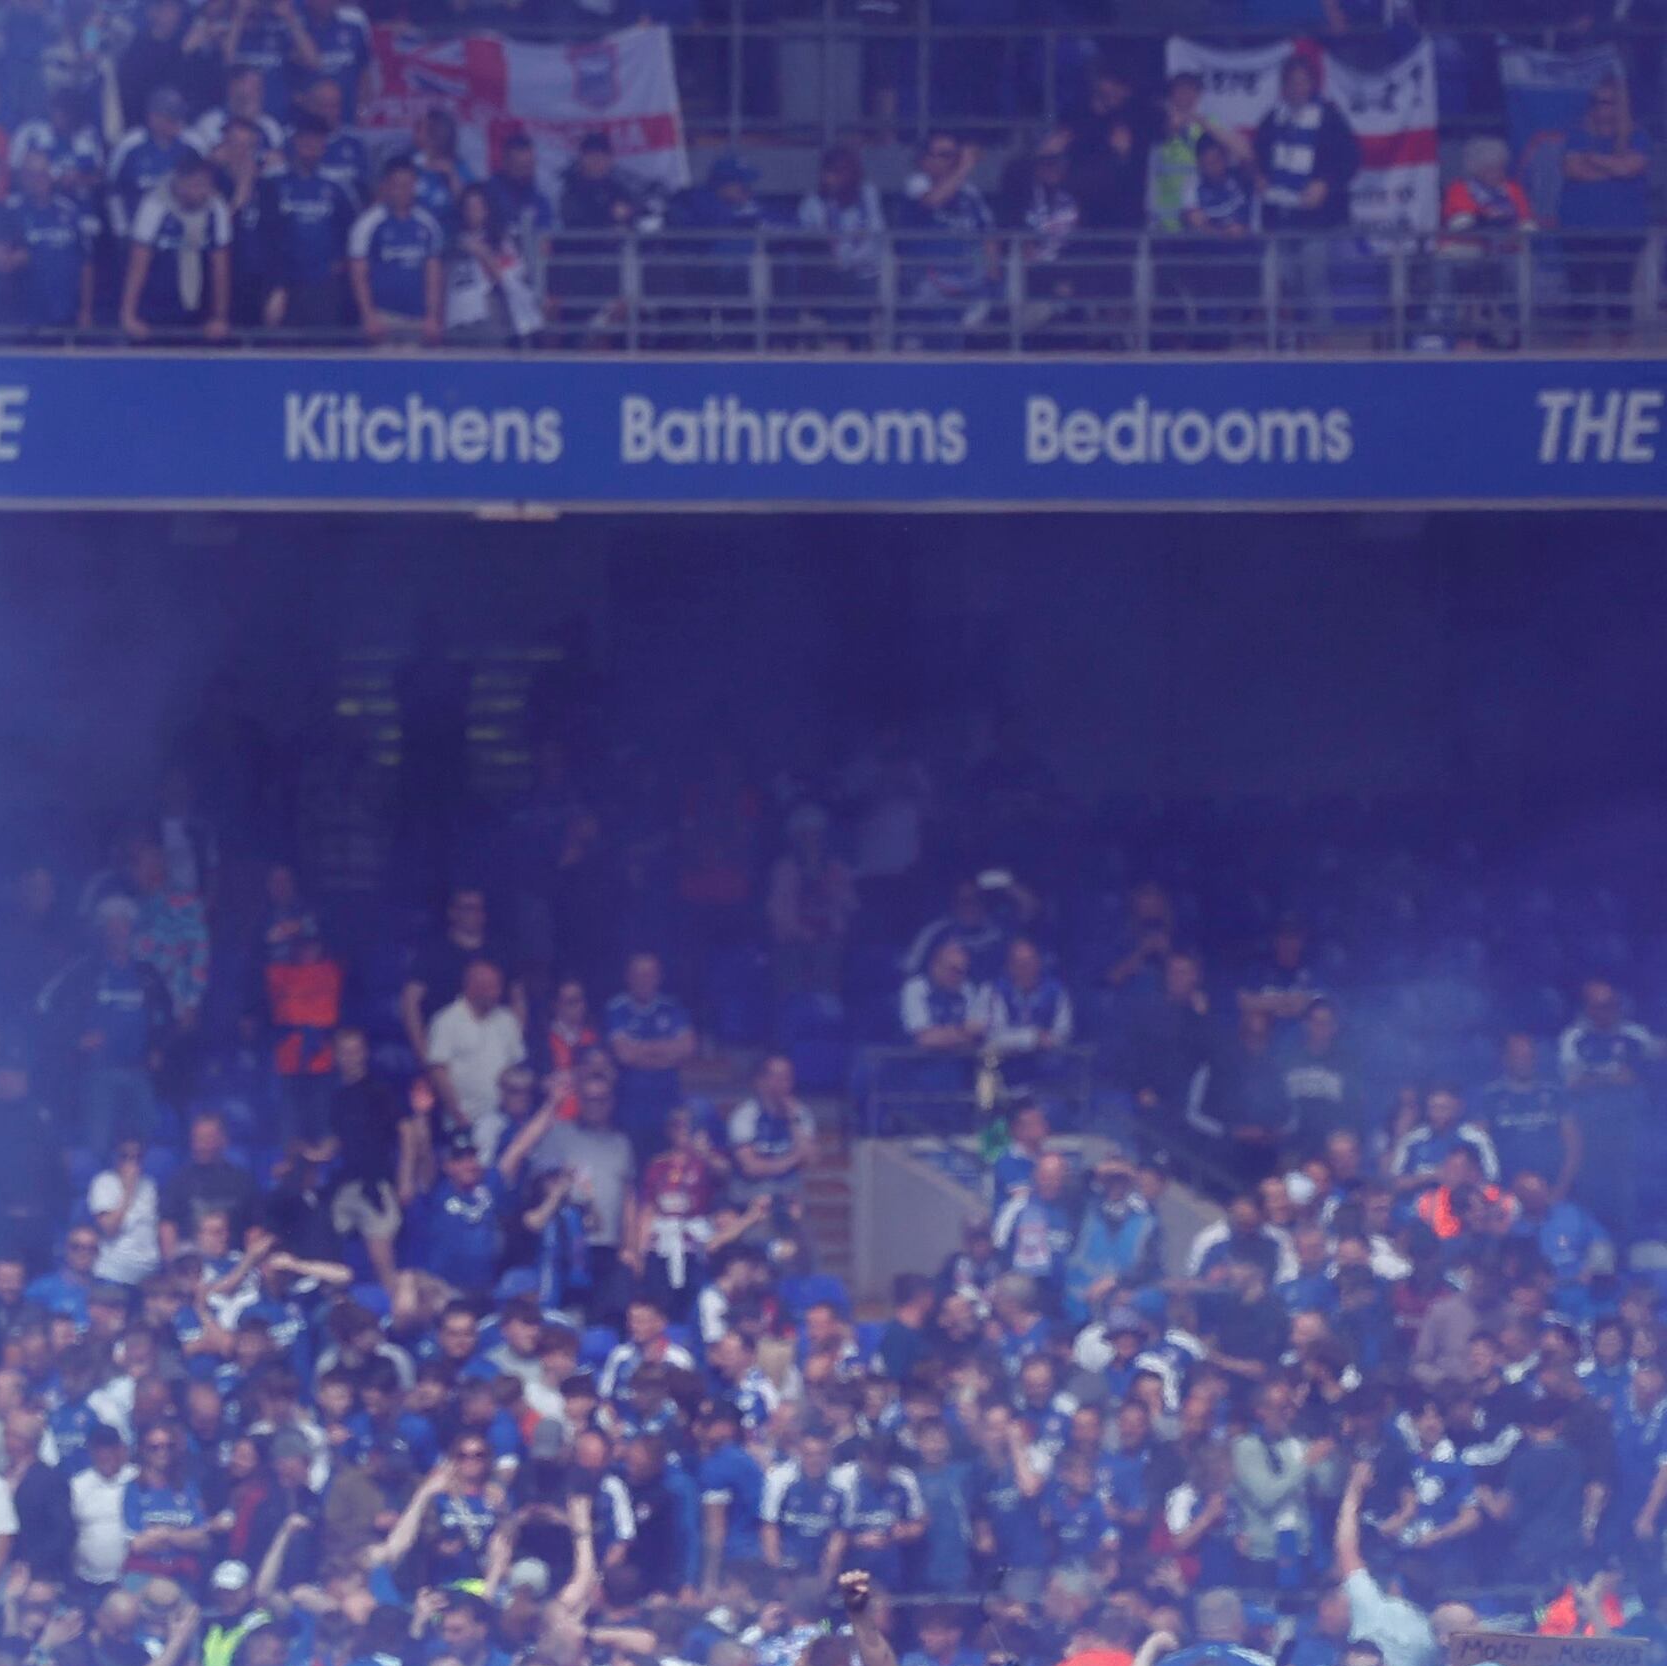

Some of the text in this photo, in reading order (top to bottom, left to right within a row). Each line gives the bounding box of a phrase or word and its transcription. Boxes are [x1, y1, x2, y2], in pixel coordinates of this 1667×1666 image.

[284, 393, 1353, 465] Kitchens Bathrooms Bedrooms
[1537, 391, 1663, 463] THE
